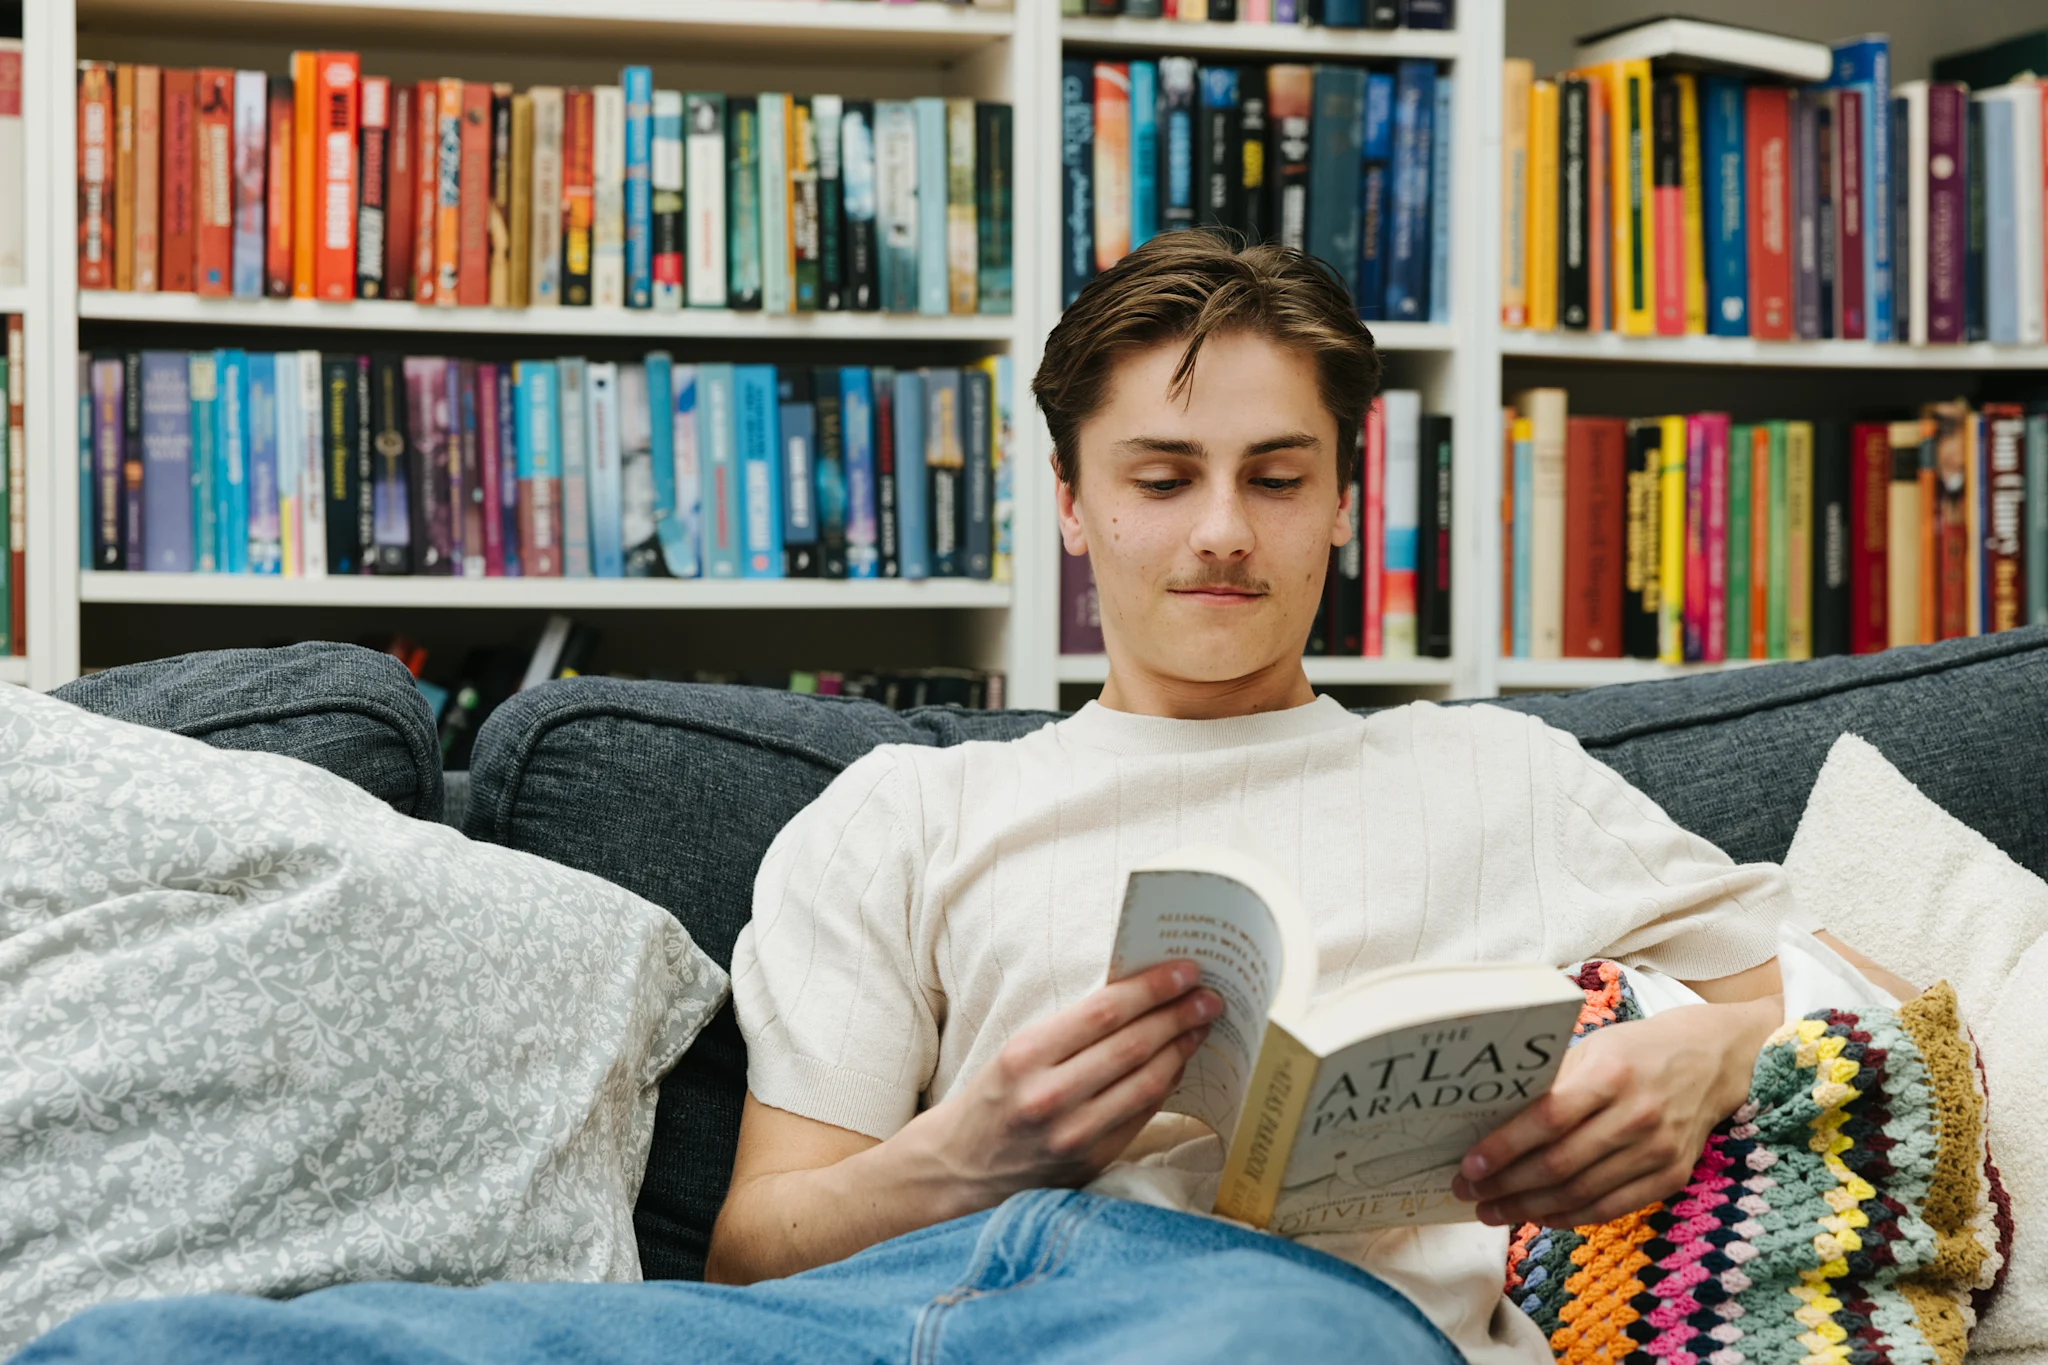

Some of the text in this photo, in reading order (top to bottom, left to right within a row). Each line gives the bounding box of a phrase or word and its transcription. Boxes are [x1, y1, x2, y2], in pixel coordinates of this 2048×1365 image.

[1418, 1025, 1475, 1048] THE
[1315, 1033, 1558, 1112] ATLAS
[1312, 1075, 1537, 1136] PARADOX
[1277, 1200, 1385, 1234] OLIVIE
